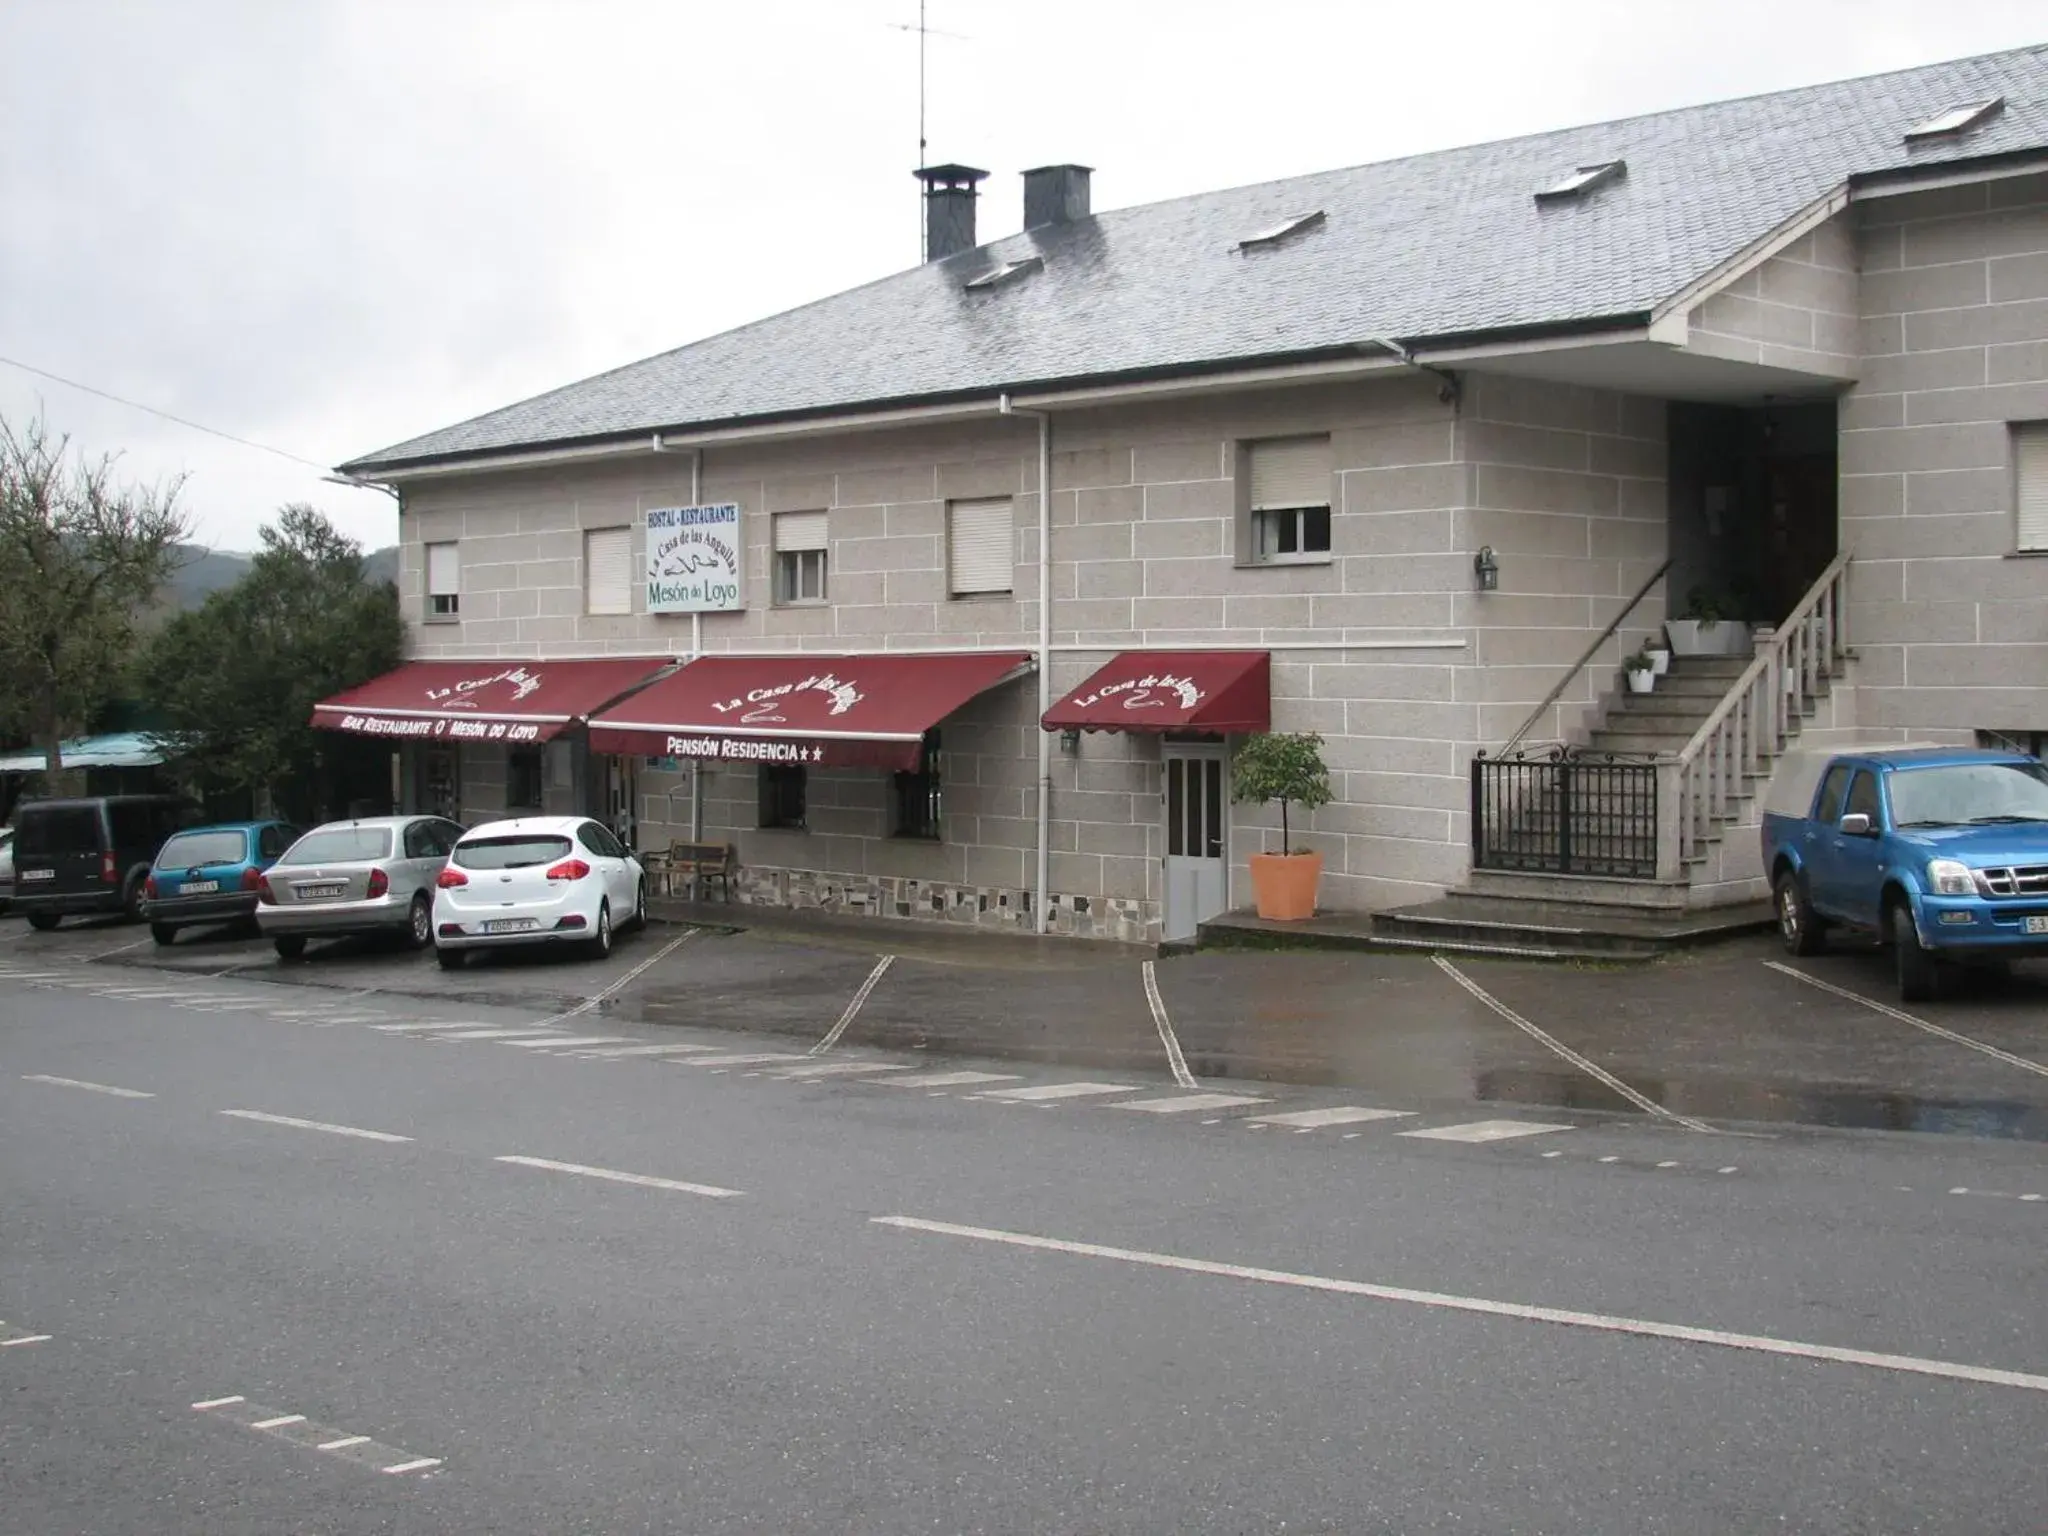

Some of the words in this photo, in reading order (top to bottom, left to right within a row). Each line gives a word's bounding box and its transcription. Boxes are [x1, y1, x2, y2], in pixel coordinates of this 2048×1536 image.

[648, 510, 675, 528] HOSTAL
[680, 505, 736, 525] RESTAURANTE
[658, 536, 678, 558] Casa
[680, 530, 690, 545] de
[691, 526, 703, 544] las
[648, 581, 689, 605] Mesón
[704, 579, 737, 607] Loyo
[711, 698, 743, 713] La
[1072, 694, 1099, 708] La
[341, 715, 365, 729] BAR
[488, 723, 506, 738] DO
[507, 723, 539, 740] LOYO
[667, 735, 719, 757] PENSIÓN
[721, 738, 798, 761] RESIDENCIA
